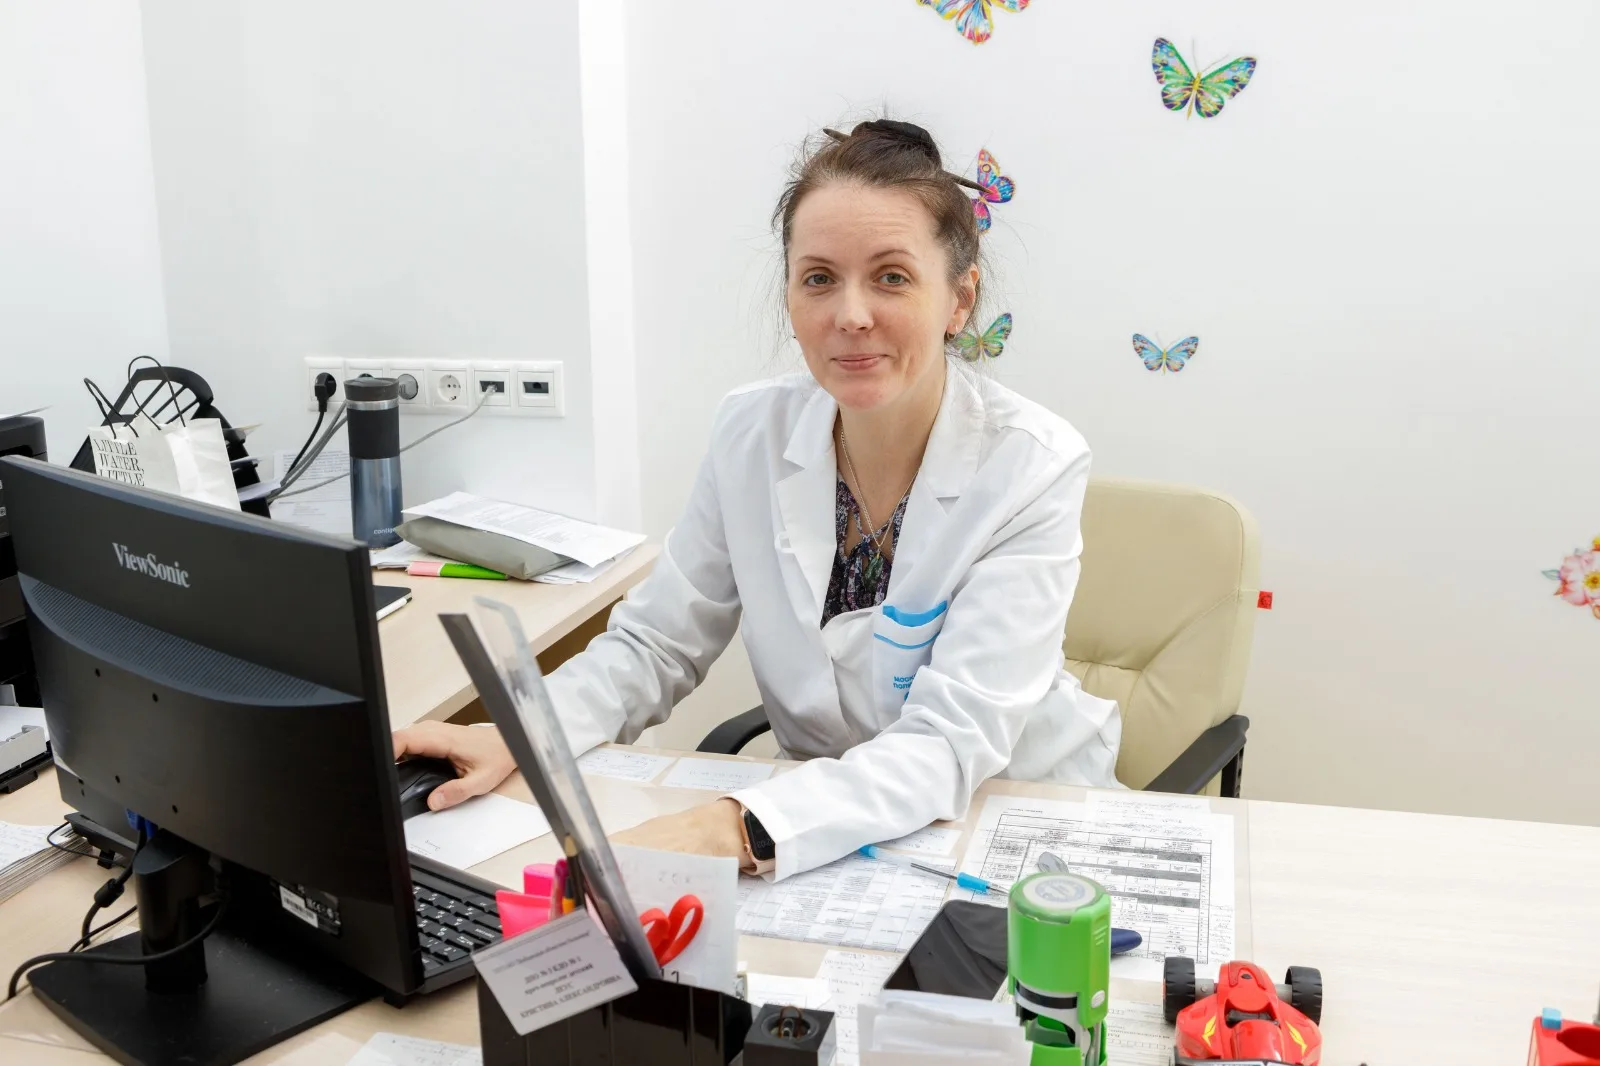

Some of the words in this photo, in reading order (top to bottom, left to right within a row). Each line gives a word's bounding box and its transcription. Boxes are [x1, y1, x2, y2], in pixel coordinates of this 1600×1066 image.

[93, 439, 137, 455] LITTLE
[100, 453, 144, 474] WATER,
[373, 527, 396, 535] contig
[112, 542, 191, 588] ViewSonic
